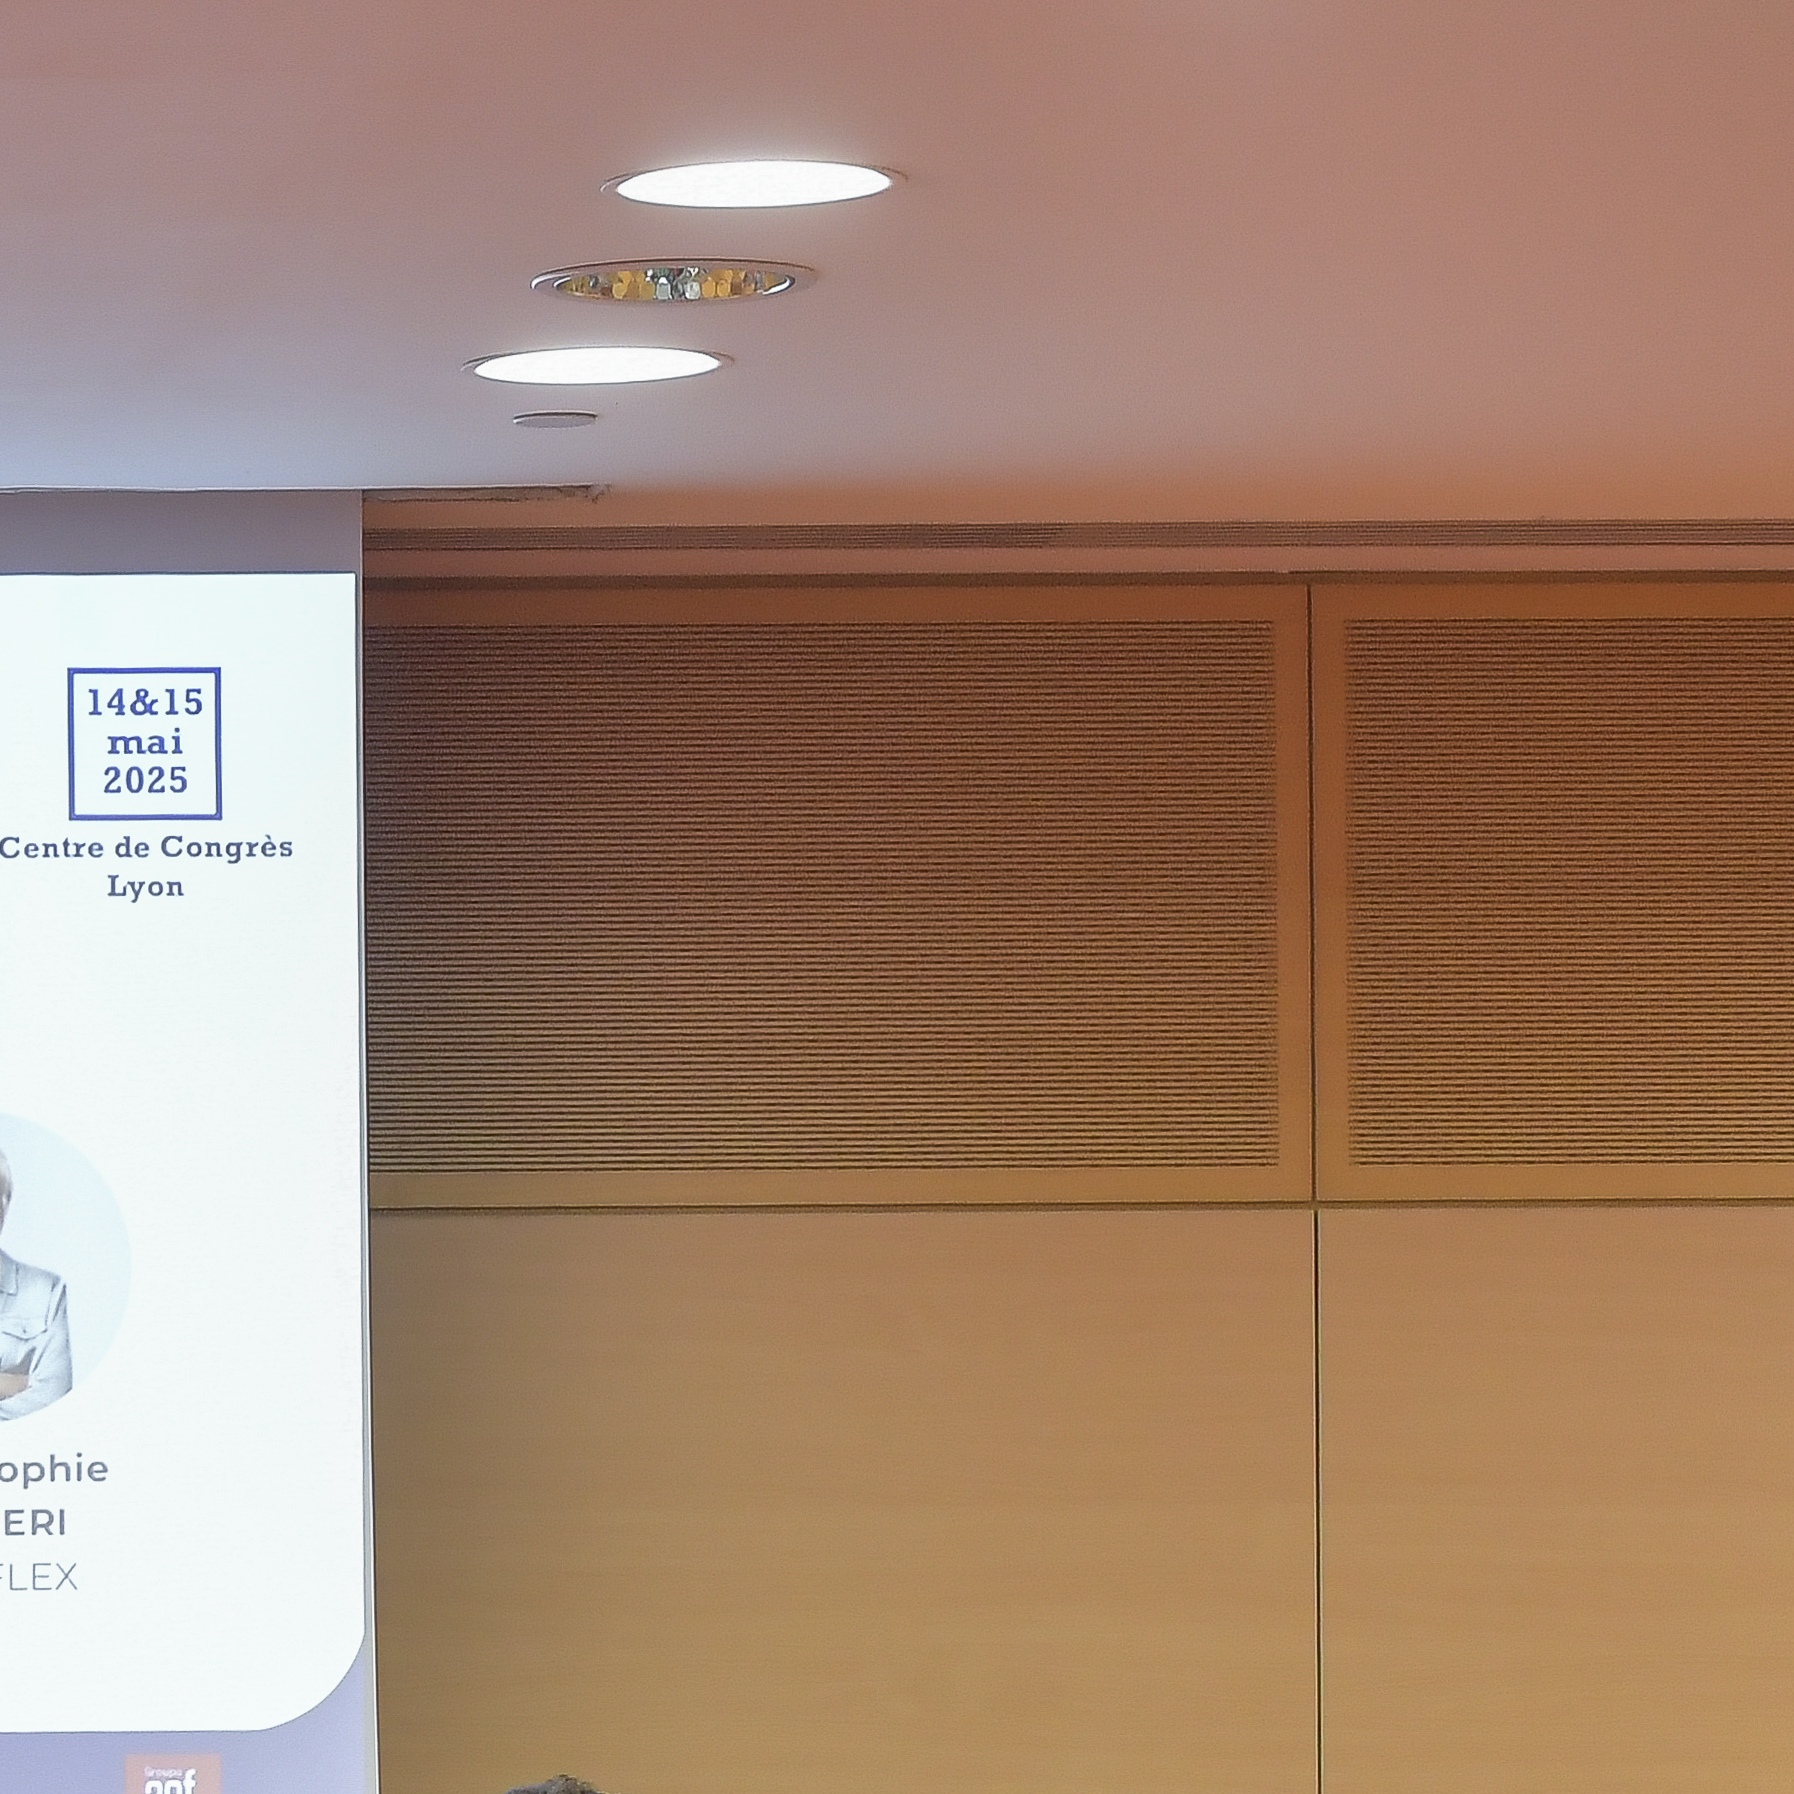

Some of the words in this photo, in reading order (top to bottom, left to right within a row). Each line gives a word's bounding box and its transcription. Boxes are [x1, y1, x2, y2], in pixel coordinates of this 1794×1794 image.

[89, 688, 202, 715] 14&15
[107, 727, 183, 754] mai
[104, 766, 187, 793] 2025
[0, 837, 103, 858] Centre
[115, 836, 149, 858] de
[161, 835, 292, 864] Congrès
[108, 875, 184, 903] Lyon
